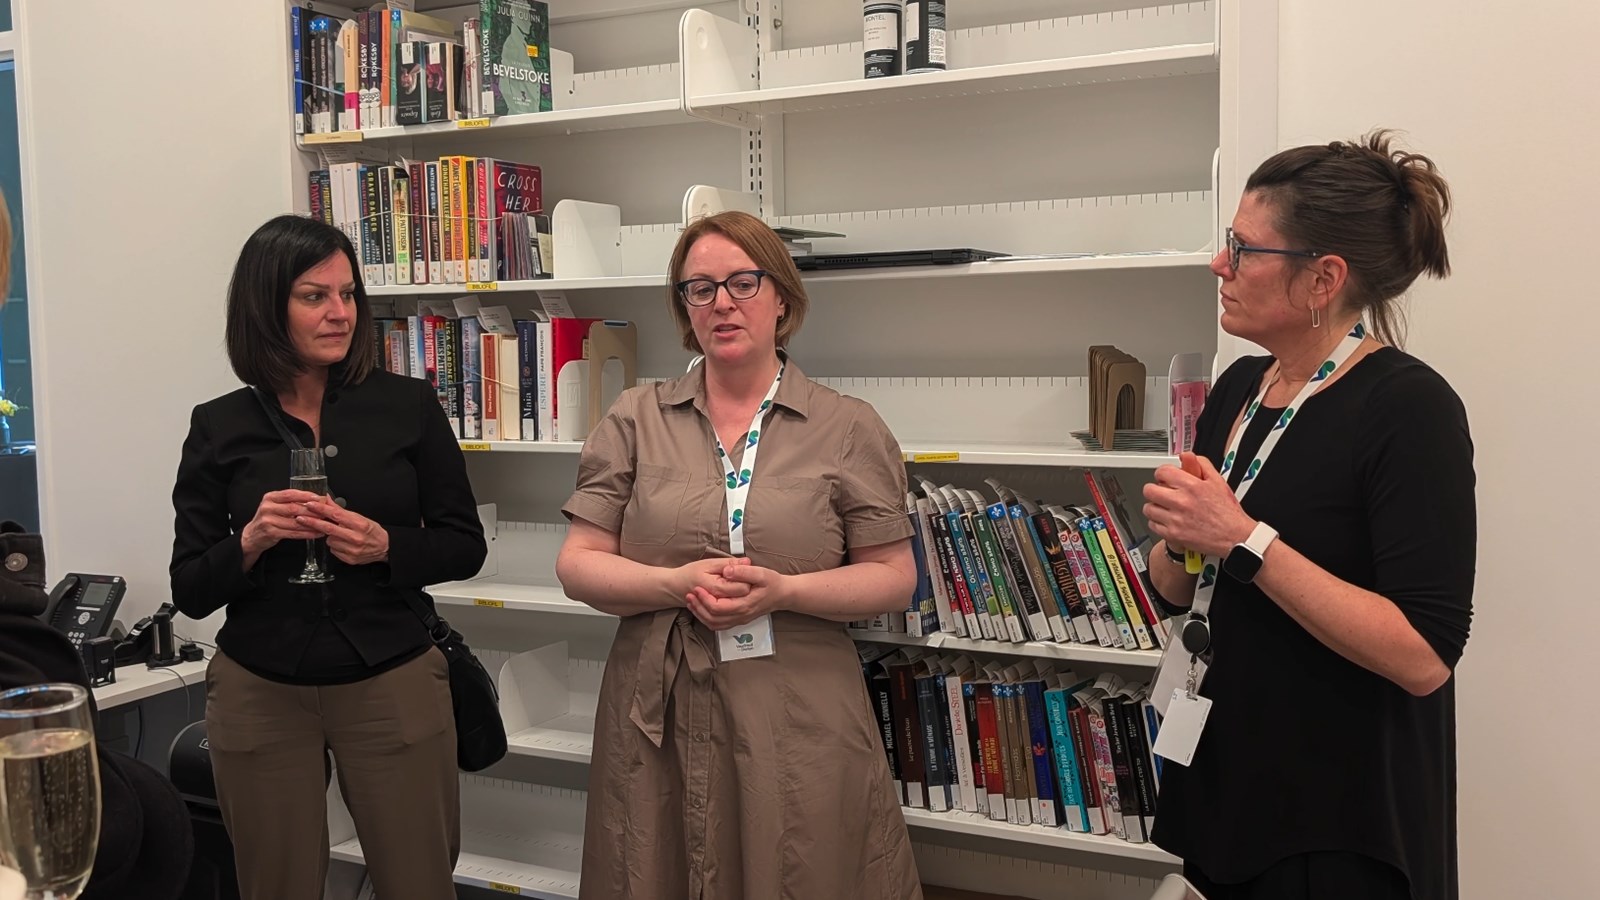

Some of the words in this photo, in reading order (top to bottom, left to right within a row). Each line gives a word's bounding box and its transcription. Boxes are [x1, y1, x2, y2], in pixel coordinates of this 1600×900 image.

[497, 5, 515, 17] JULIA
[492, 63, 550, 84] BEVELSTOKE
[367, 172, 375, 197] GRAVE
[497, 171, 538, 192] CROSS
[505, 194, 531, 212] HER
[369, 201, 377, 232] DANGER
[436, 331, 445, 354] JAMES
[438, 355, 446, 392] PATTERSON
[523, 392, 532, 417] Maia
[944, 536, 954, 556] SUPER
[950, 556, 959, 574] CHIEN
[956, 573, 962, 582] 12
[969, 539, 977, 557] SUPER
[984, 541, 993, 557] SUPER
[958, 537, 967, 556] SUPER
[963, 557, 972, 575] CHIEN
[969, 575, 976, 584] 10
[880, 691, 889, 721] CONNELLY
[951, 686, 959, 708] STEEL
[883, 722, 893, 750] MICHAEL
